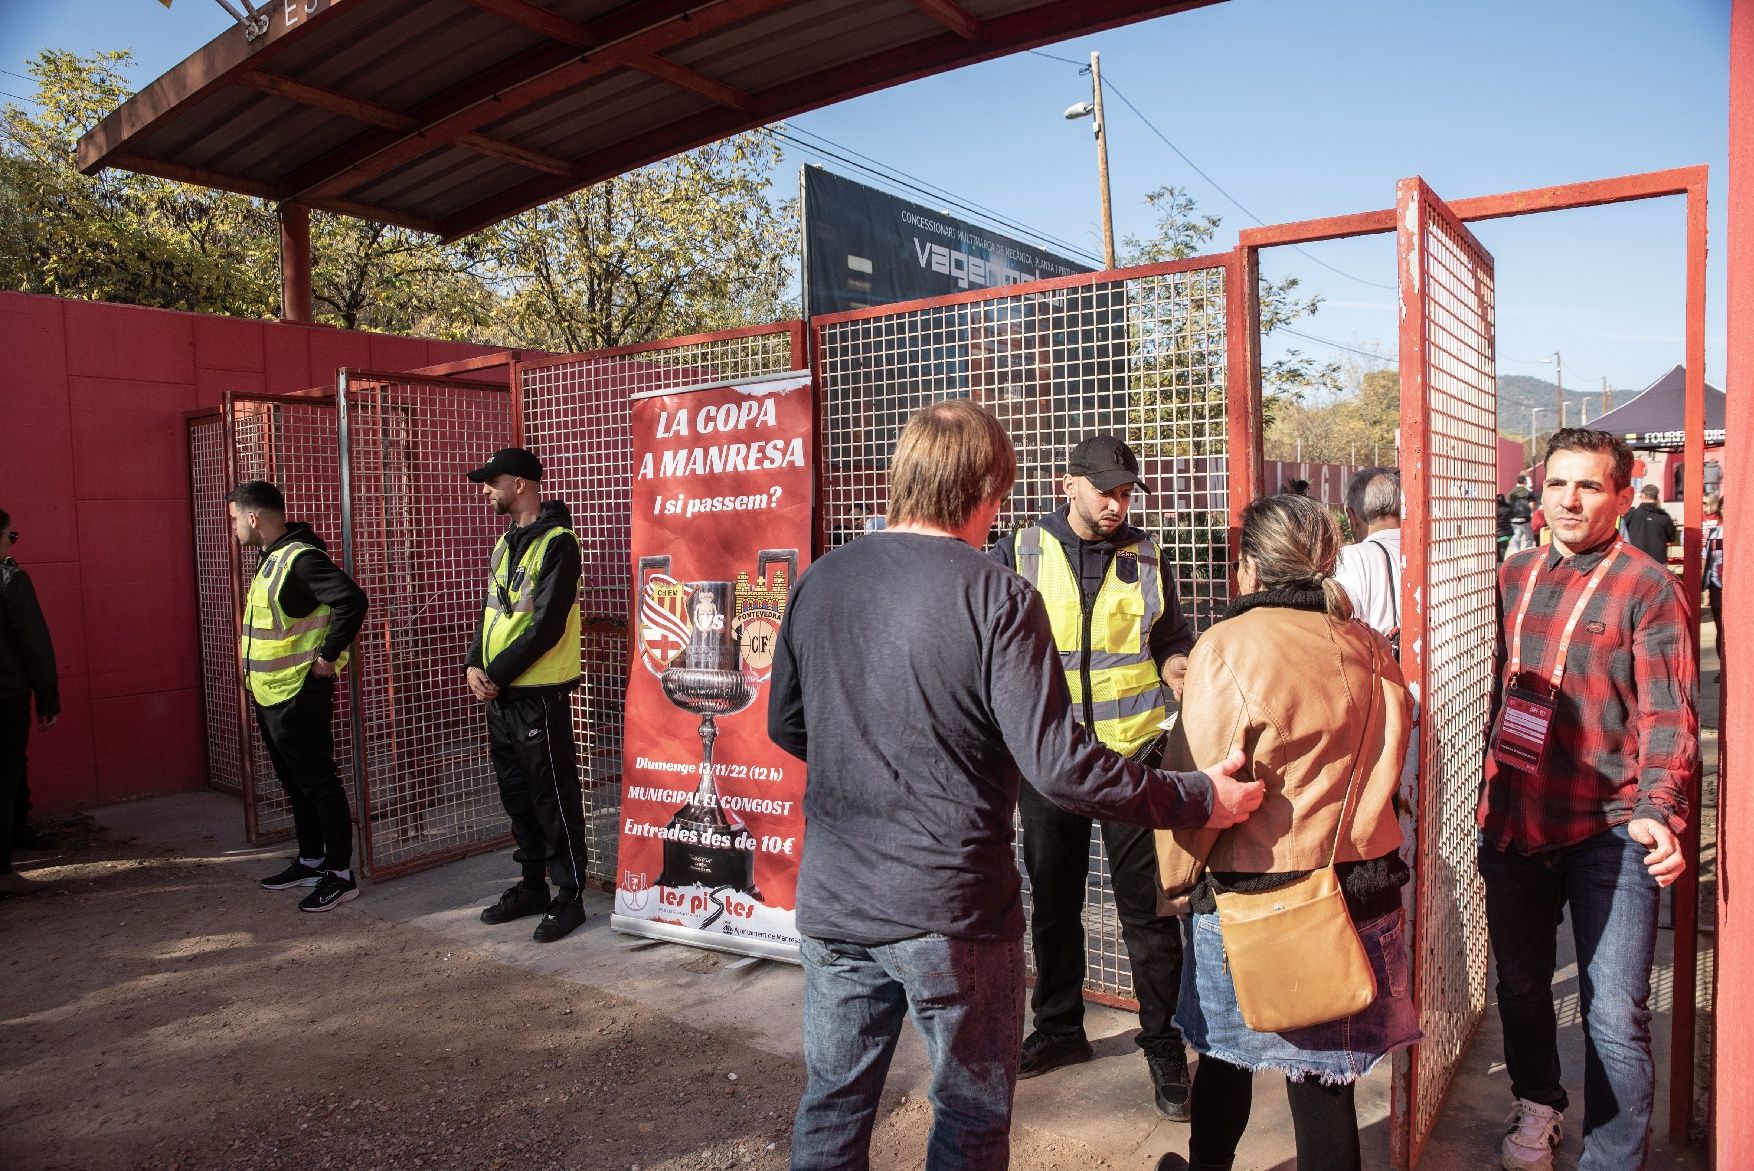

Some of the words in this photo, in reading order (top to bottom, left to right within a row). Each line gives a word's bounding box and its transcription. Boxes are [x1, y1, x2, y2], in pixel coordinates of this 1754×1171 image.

[901, 210, 956, 240] CONCESSIONARI
[957, 231, 995, 252] MULTIMARCA
[996, 243, 1004, 255] DE
[656, 408, 689, 439] LA
[696, 398, 777, 434] COPA
[638, 452, 654, 481] A
[659, 437, 805, 477] MANRESA
[653, 495, 662, 515] I
[664, 493, 684, 514] si
[685, 485, 783, 518] passem?
[737, 610, 781, 622] PONTEVEDRA
[635, 757, 696, 776] Diumenge
[698, 762, 748, 779] 13/11/22
[749, 765, 768, 780] (12
[768, 767, 783, 782] h)
[628, 785, 701, 806] MUNICIPAL
[702, 793, 718, 808] EL
[720, 795, 793, 816] CONGOST
[624, 818, 698, 843] Entrades
[701, 828, 731, 847] des
[734, 832, 756, 850] de
[761, 835, 796, 855] 10€
[659, 885, 685, 907] les
